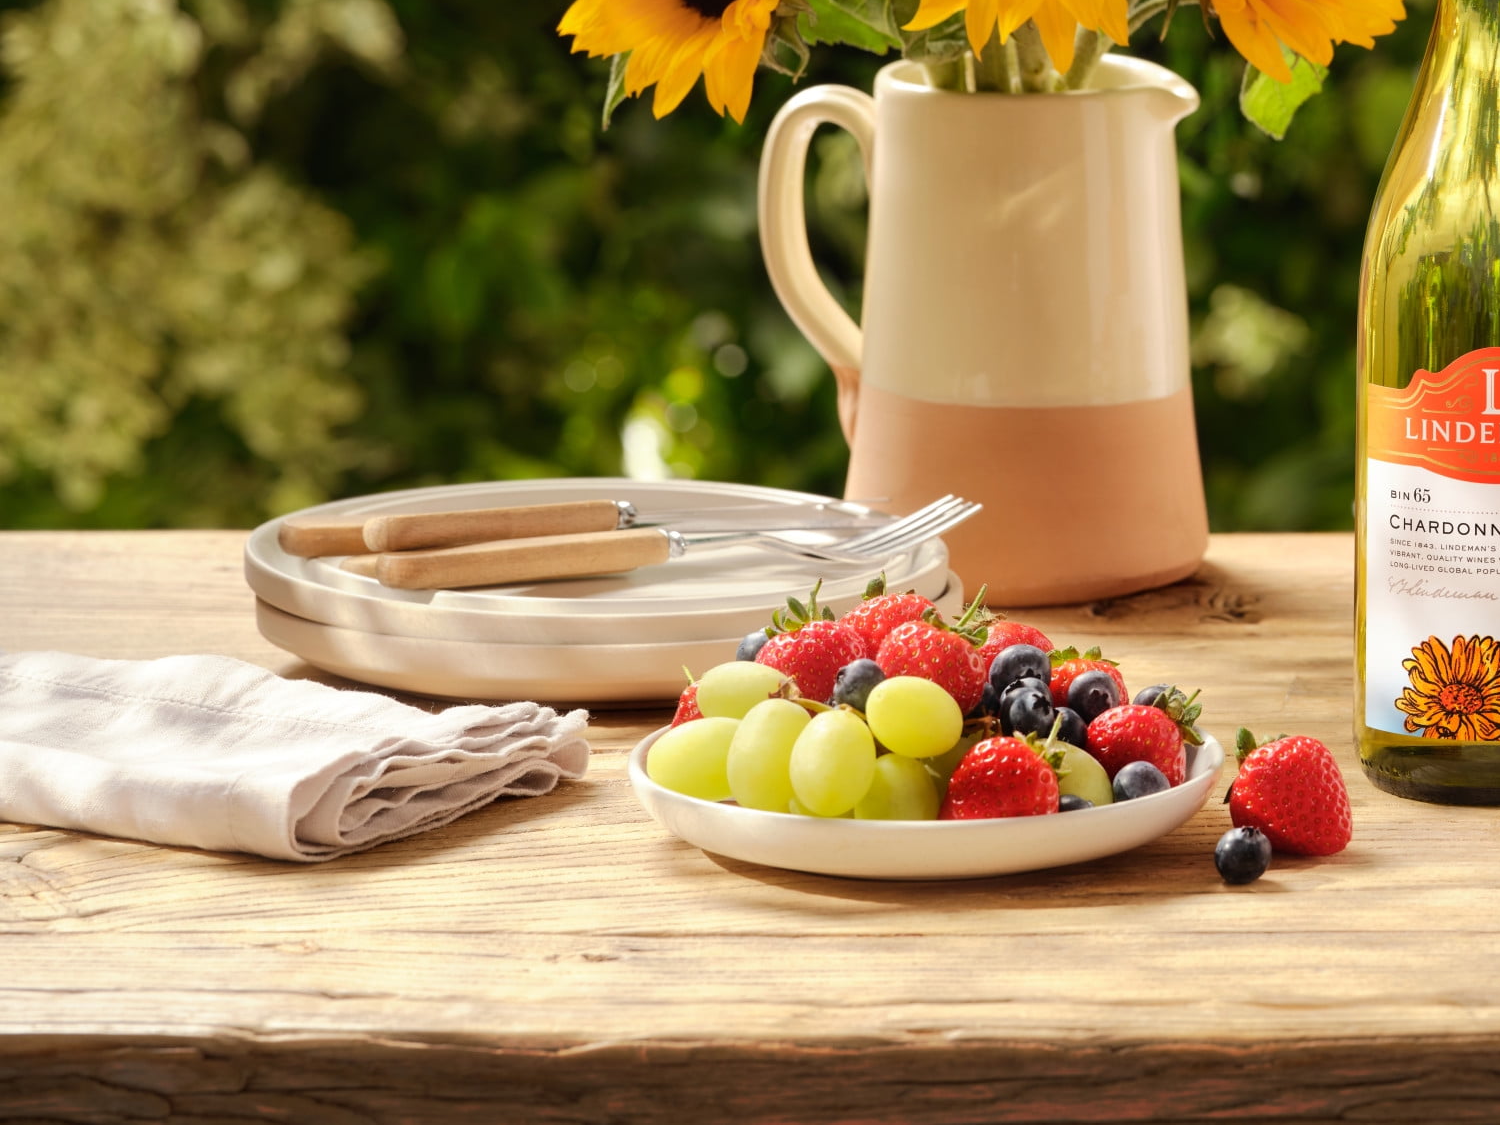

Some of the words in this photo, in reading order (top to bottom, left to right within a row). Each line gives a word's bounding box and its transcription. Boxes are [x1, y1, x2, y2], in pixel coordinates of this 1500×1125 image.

[1390, 489, 1410, 501] BIN
[1413, 487, 1431, 504] 65
[1390, 538, 1412, 548] SINCE
[1440, 543, 1497, 552] LINDEMAN'S
[1426, 554, 1463, 563] QUALITY
[1466, 556, 1496, 564] WINES
[1390, 561, 1435, 572] LONG-LIVED
[1437, 566, 1473, 575] GLOBAL
